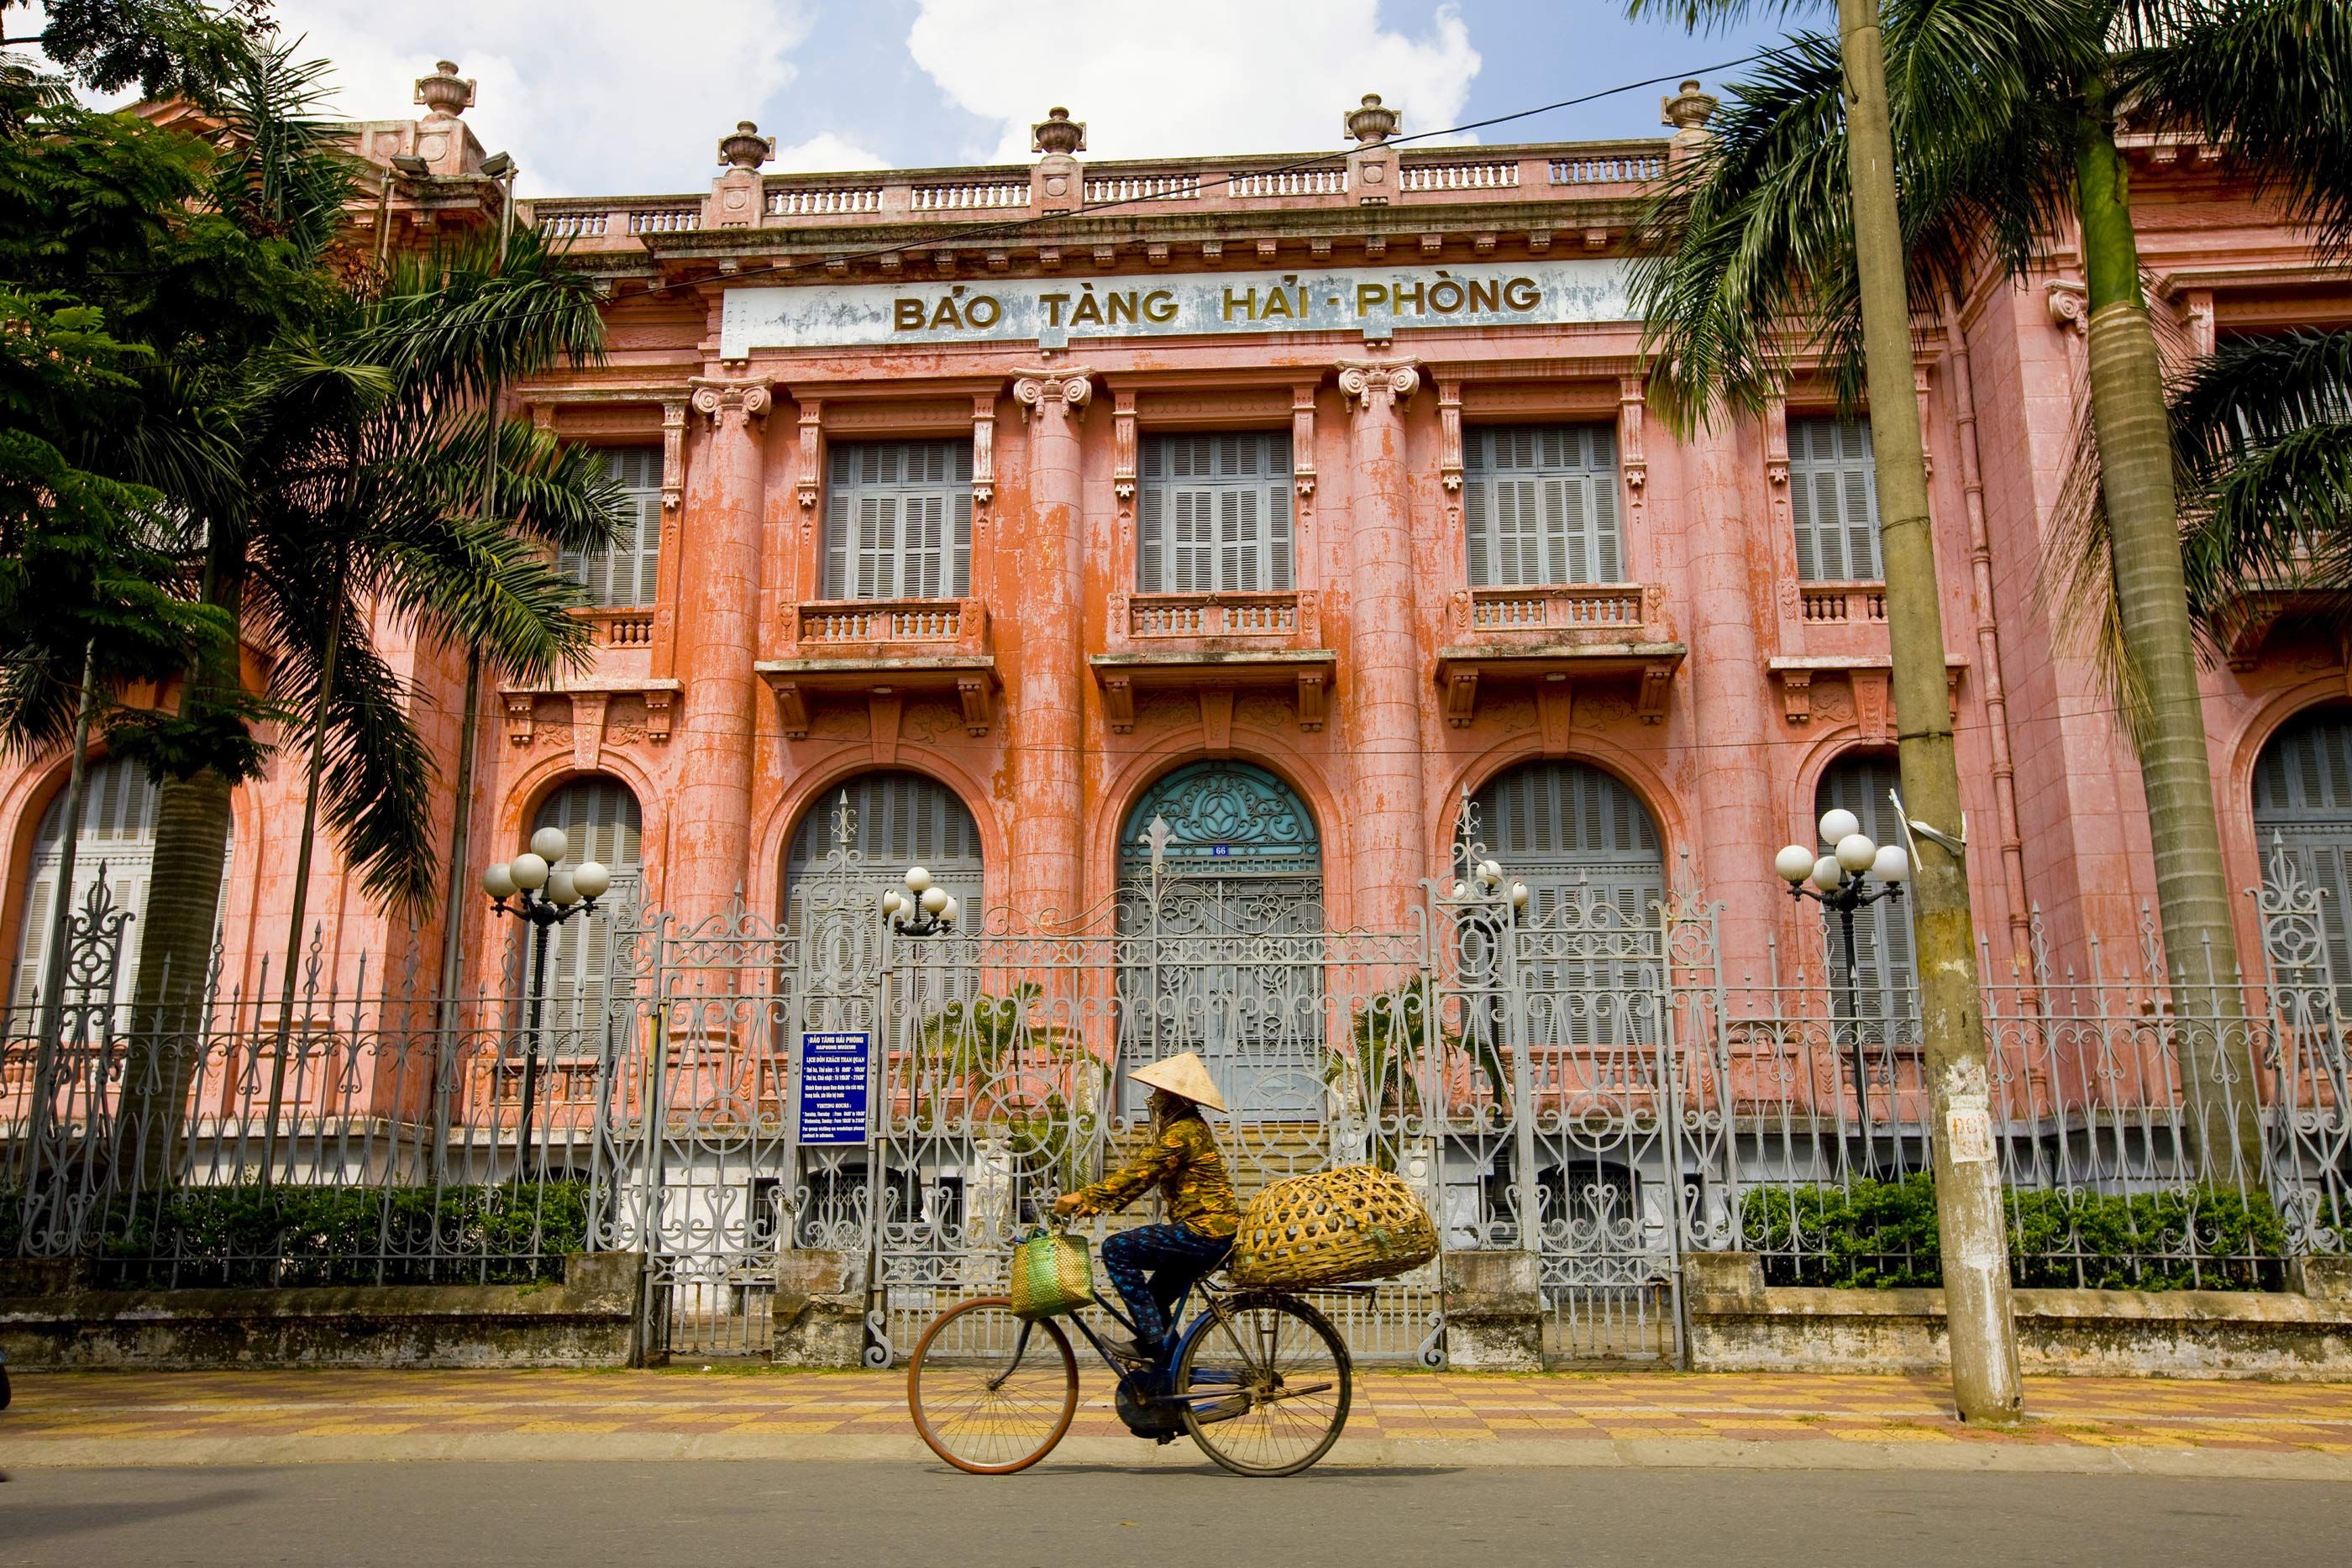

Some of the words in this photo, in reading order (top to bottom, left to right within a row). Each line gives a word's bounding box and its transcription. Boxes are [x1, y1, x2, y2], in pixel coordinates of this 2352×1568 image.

[895, 286, 1001, 332] BẢO
[1039, 283, 1179, 327] TÀNG
[1224, 275, 1308, 321] HẢI
[1357, 270, 1541, 317] PHÒNG
